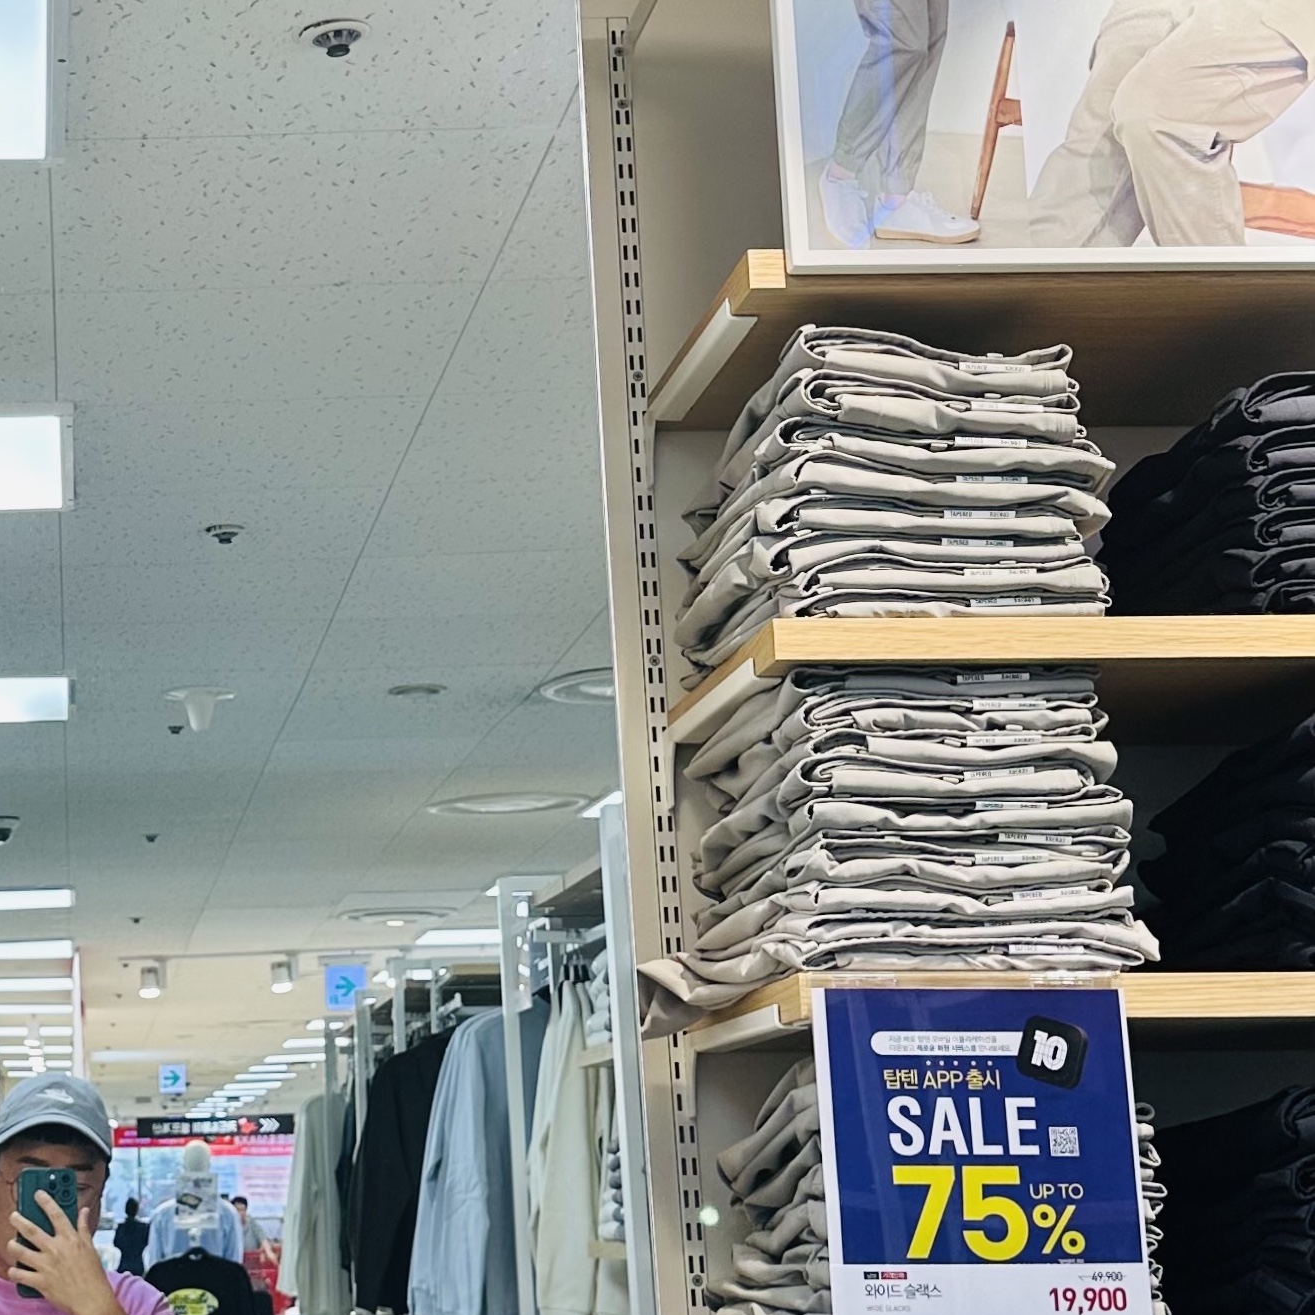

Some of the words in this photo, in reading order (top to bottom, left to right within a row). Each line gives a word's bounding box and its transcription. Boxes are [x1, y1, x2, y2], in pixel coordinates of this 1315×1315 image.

[1031, 1029, 1068, 1071] 10
[883, 1068, 919, 1090] 탑텐
[922, 1070, 963, 1090] APP
[965, 1068, 1001, 1091] 출시
[886, 1095, 1040, 1157] SALE
[1029, 1183, 1055, 1199] UP
[1057, 1183, 1084, 1199] TO
[864, 1283, 903, 1299] 와이드
[904, 1284, 943, 1299] 슬랙스
[1049, 1287, 1127, 1315] 19,900
